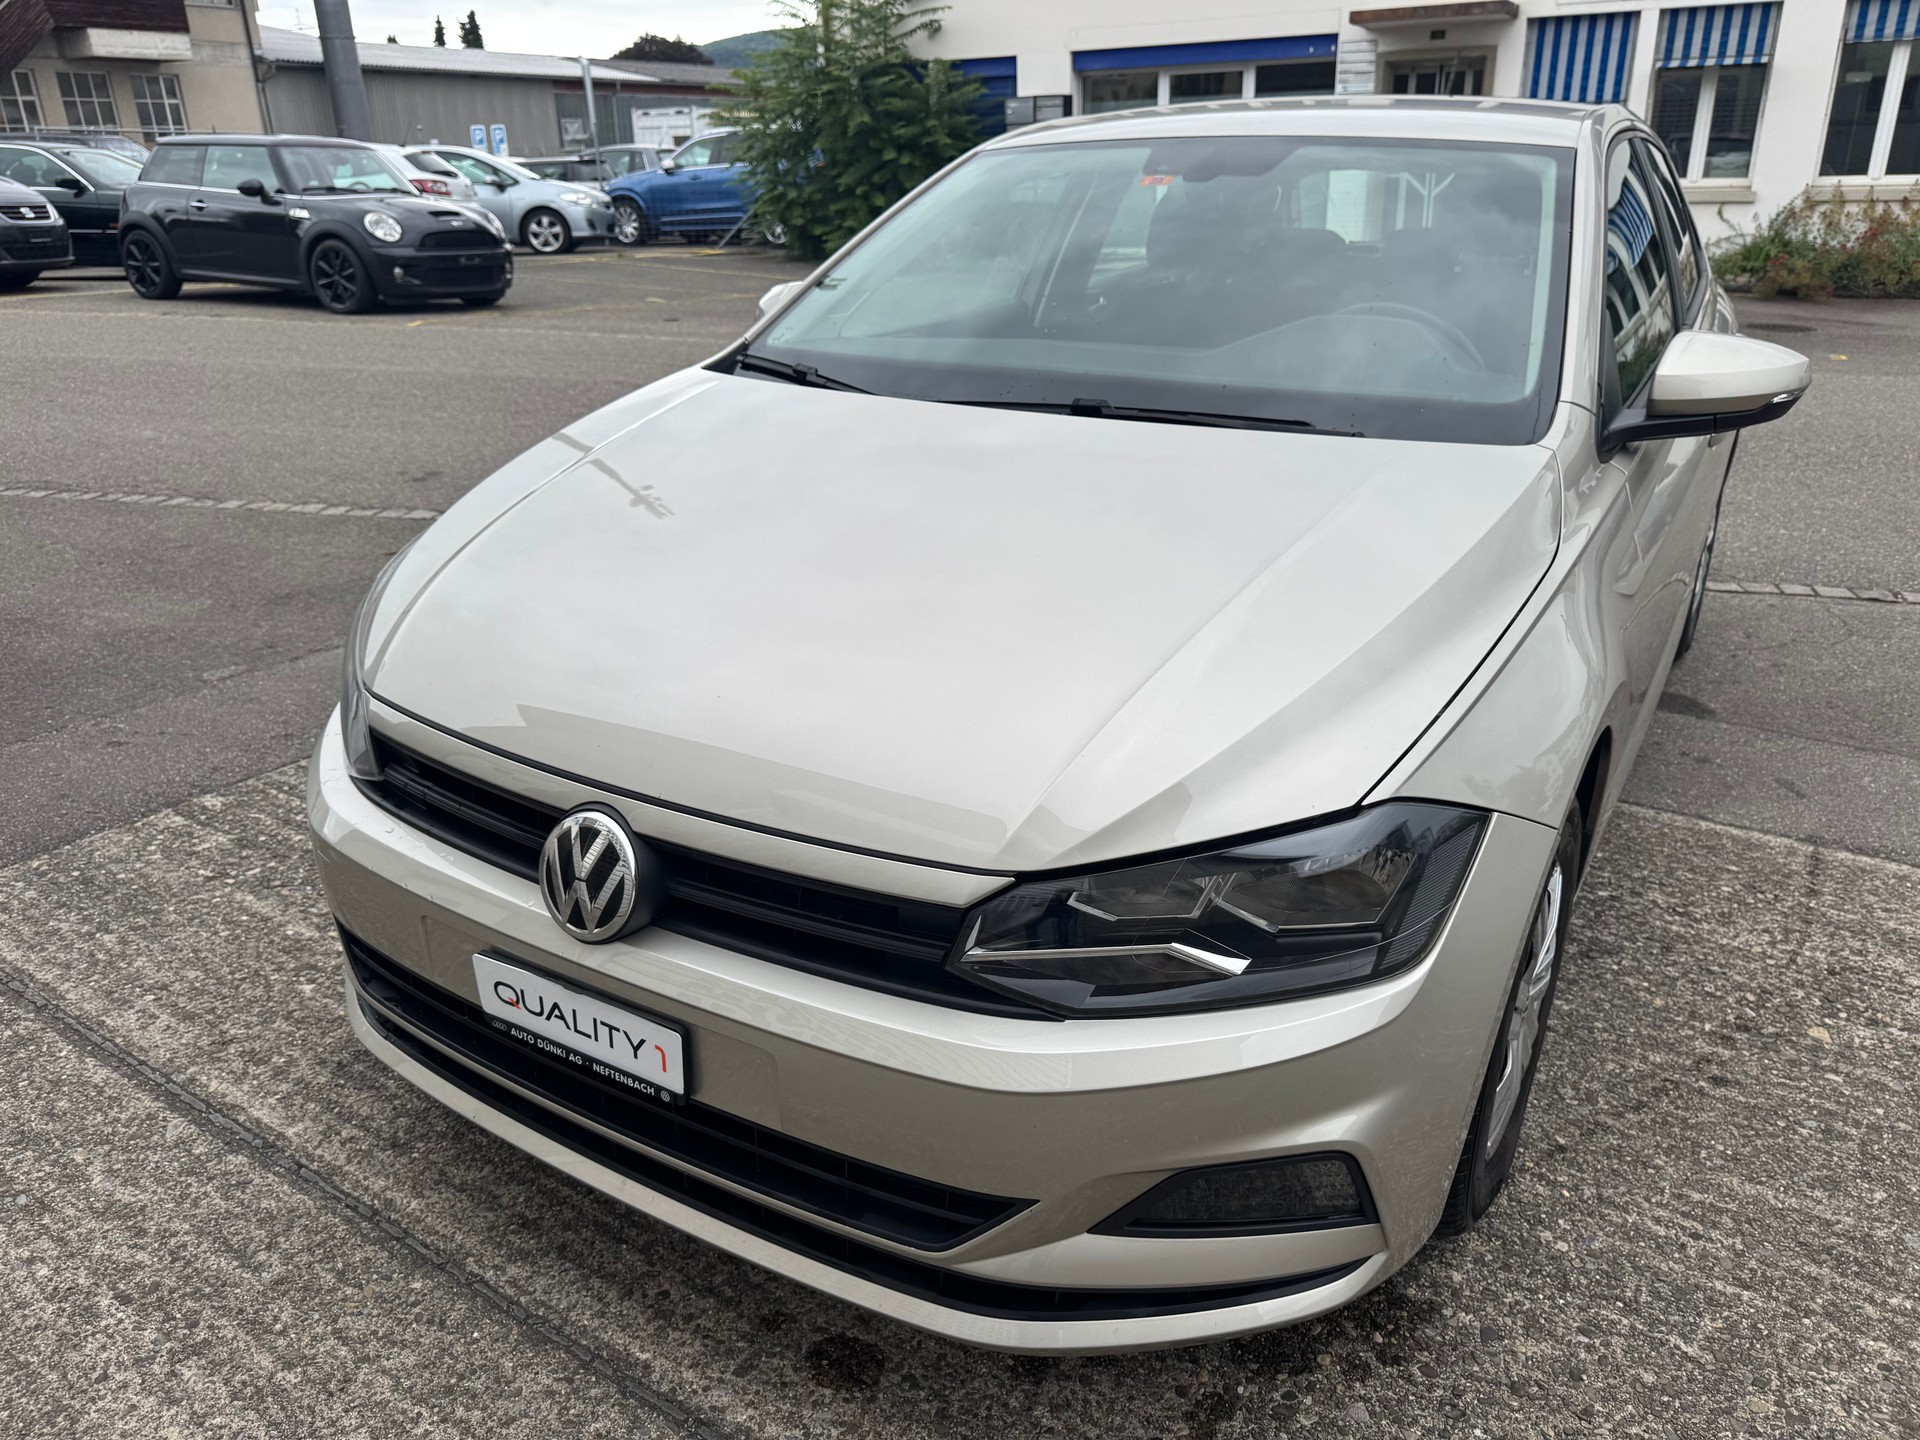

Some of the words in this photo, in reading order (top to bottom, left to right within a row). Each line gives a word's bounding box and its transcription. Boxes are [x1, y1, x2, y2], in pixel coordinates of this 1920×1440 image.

[545, 815, 632, 938] VW
[494, 980, 646, 1059] QUALITY
[655, 1044, 667, 1073] 1
[510, 1027, 535, 1044] AUTO
[537, 1038, 566, 1058] DÜNKI
[568, 1053, 583, 1065] AG
[593, 1062, 655, 1096] NEFTENBACH
